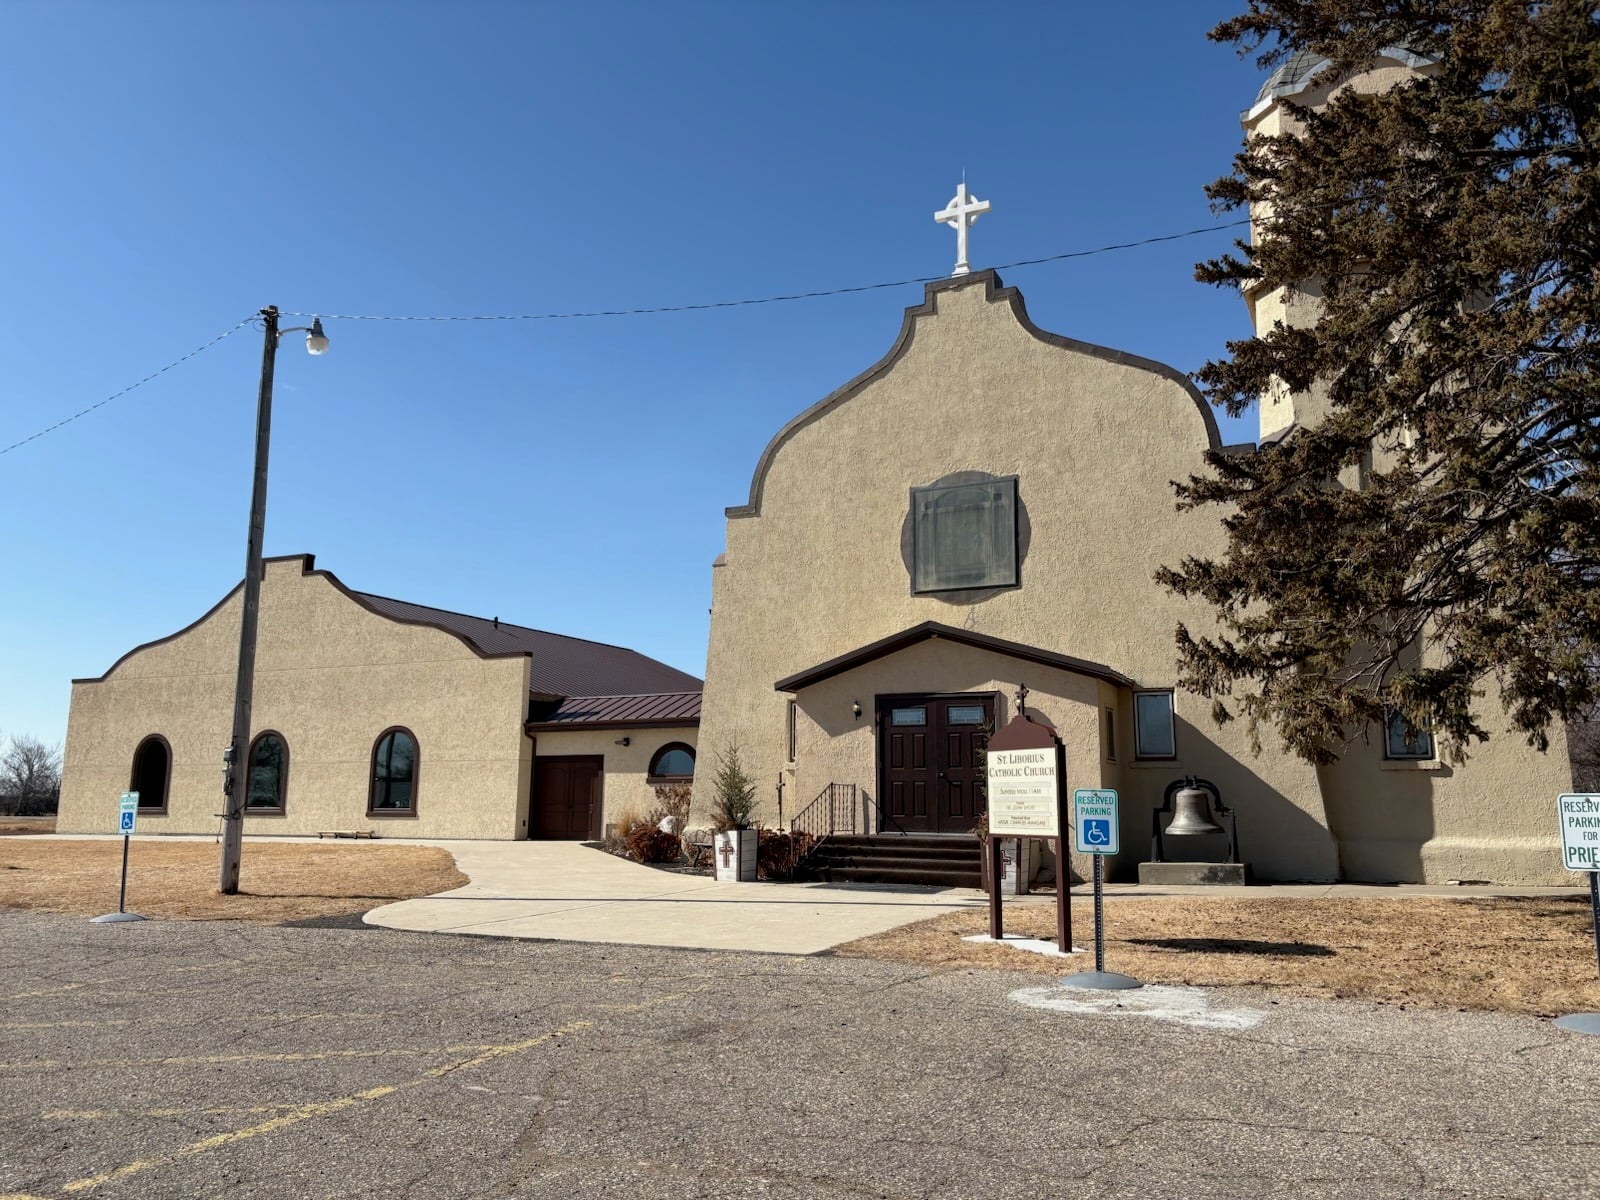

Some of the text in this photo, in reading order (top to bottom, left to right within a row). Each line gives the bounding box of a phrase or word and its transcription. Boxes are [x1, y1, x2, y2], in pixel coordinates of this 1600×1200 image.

[1009, 753, 1045, 764] LIBORIUS
[989, 766, 1055, 778] CATHOLIC CHURCH
[1077, 796, 1114, 805] RESERVED
[1080, 807, 1112, 816] PARKING
[1563, 801, 1600, 813] RESERV
[1583, 831, 1598, 841] FOR
[1568, 846, 1600, 863] PRIE
